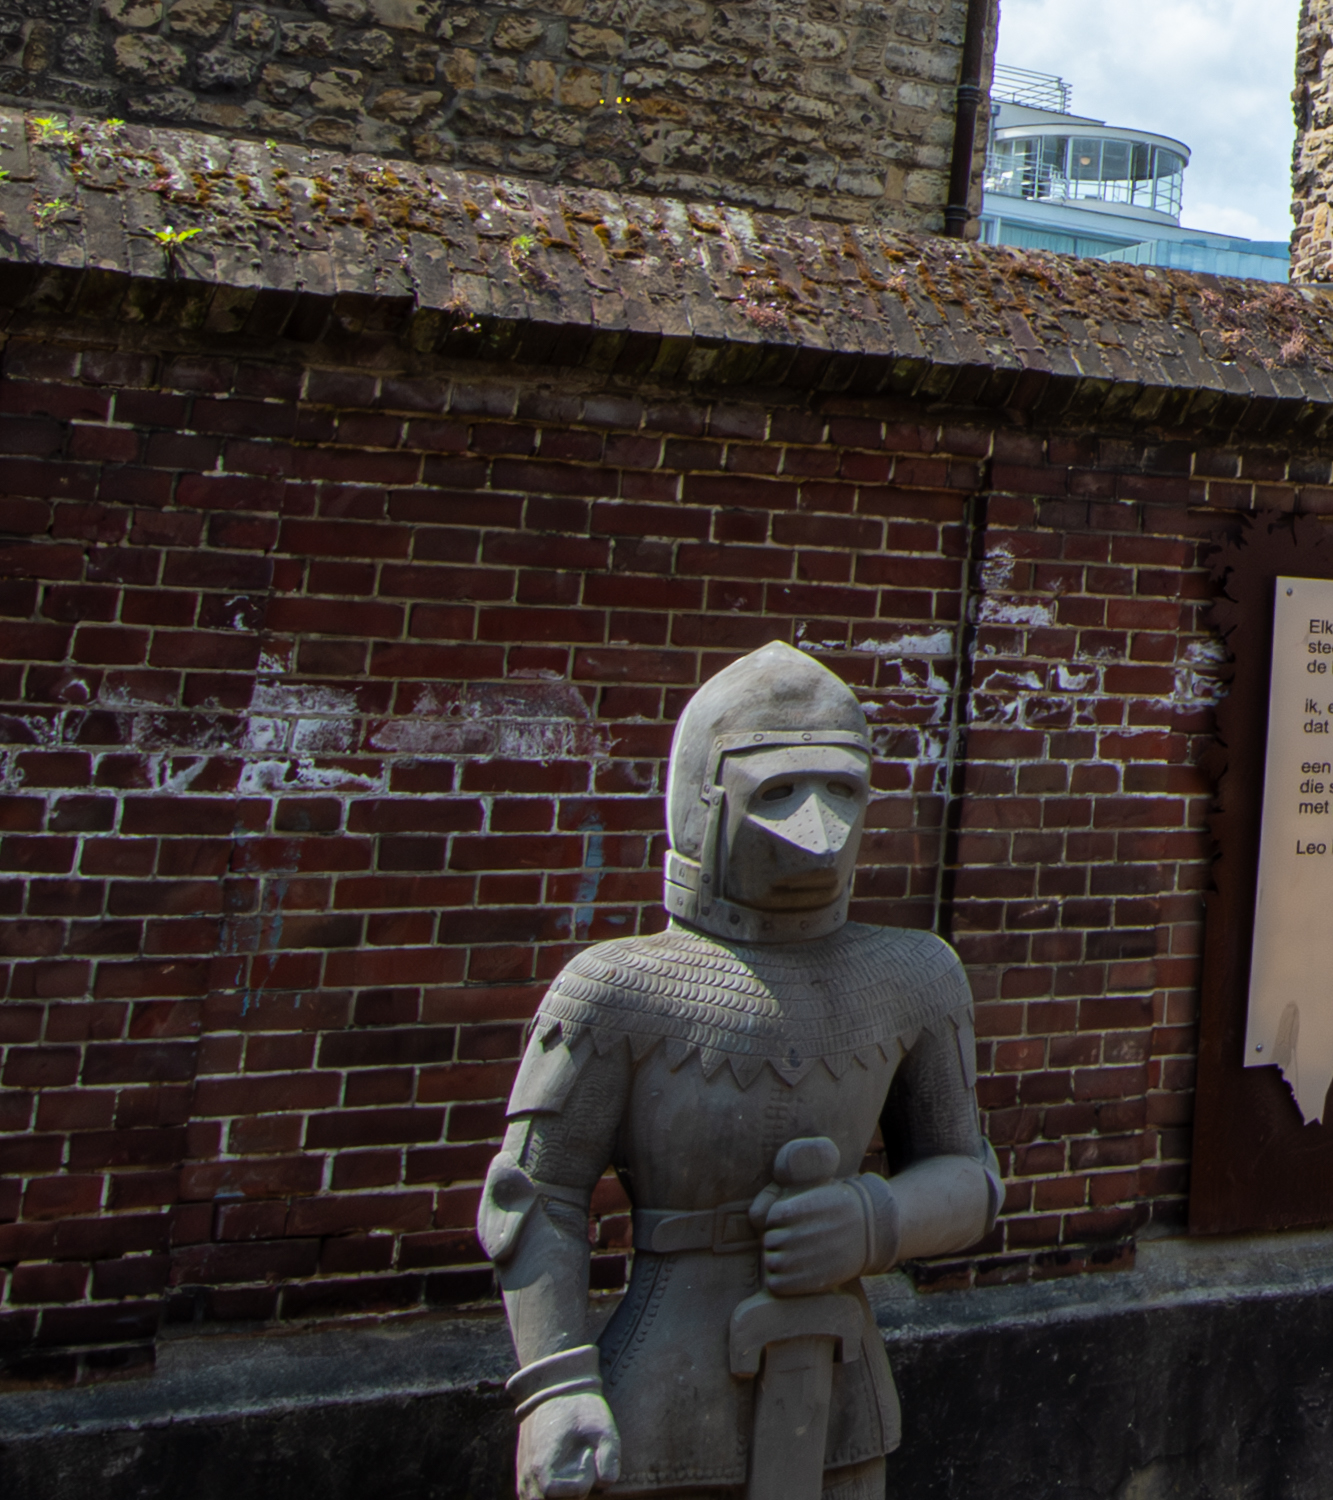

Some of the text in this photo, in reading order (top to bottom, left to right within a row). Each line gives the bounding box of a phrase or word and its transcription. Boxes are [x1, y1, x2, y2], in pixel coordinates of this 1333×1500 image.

[1307, 660, 1326, 674] de
[1305, 699, 1321, 715] ik,
[1304, 719, 1328, 733] dat
[1301, 762, 1331, 773] een
[1300, 779, 1324, 793] die
[1299, 801, 1328, 814] met
[1297, 840, 1326, 854] Leo
